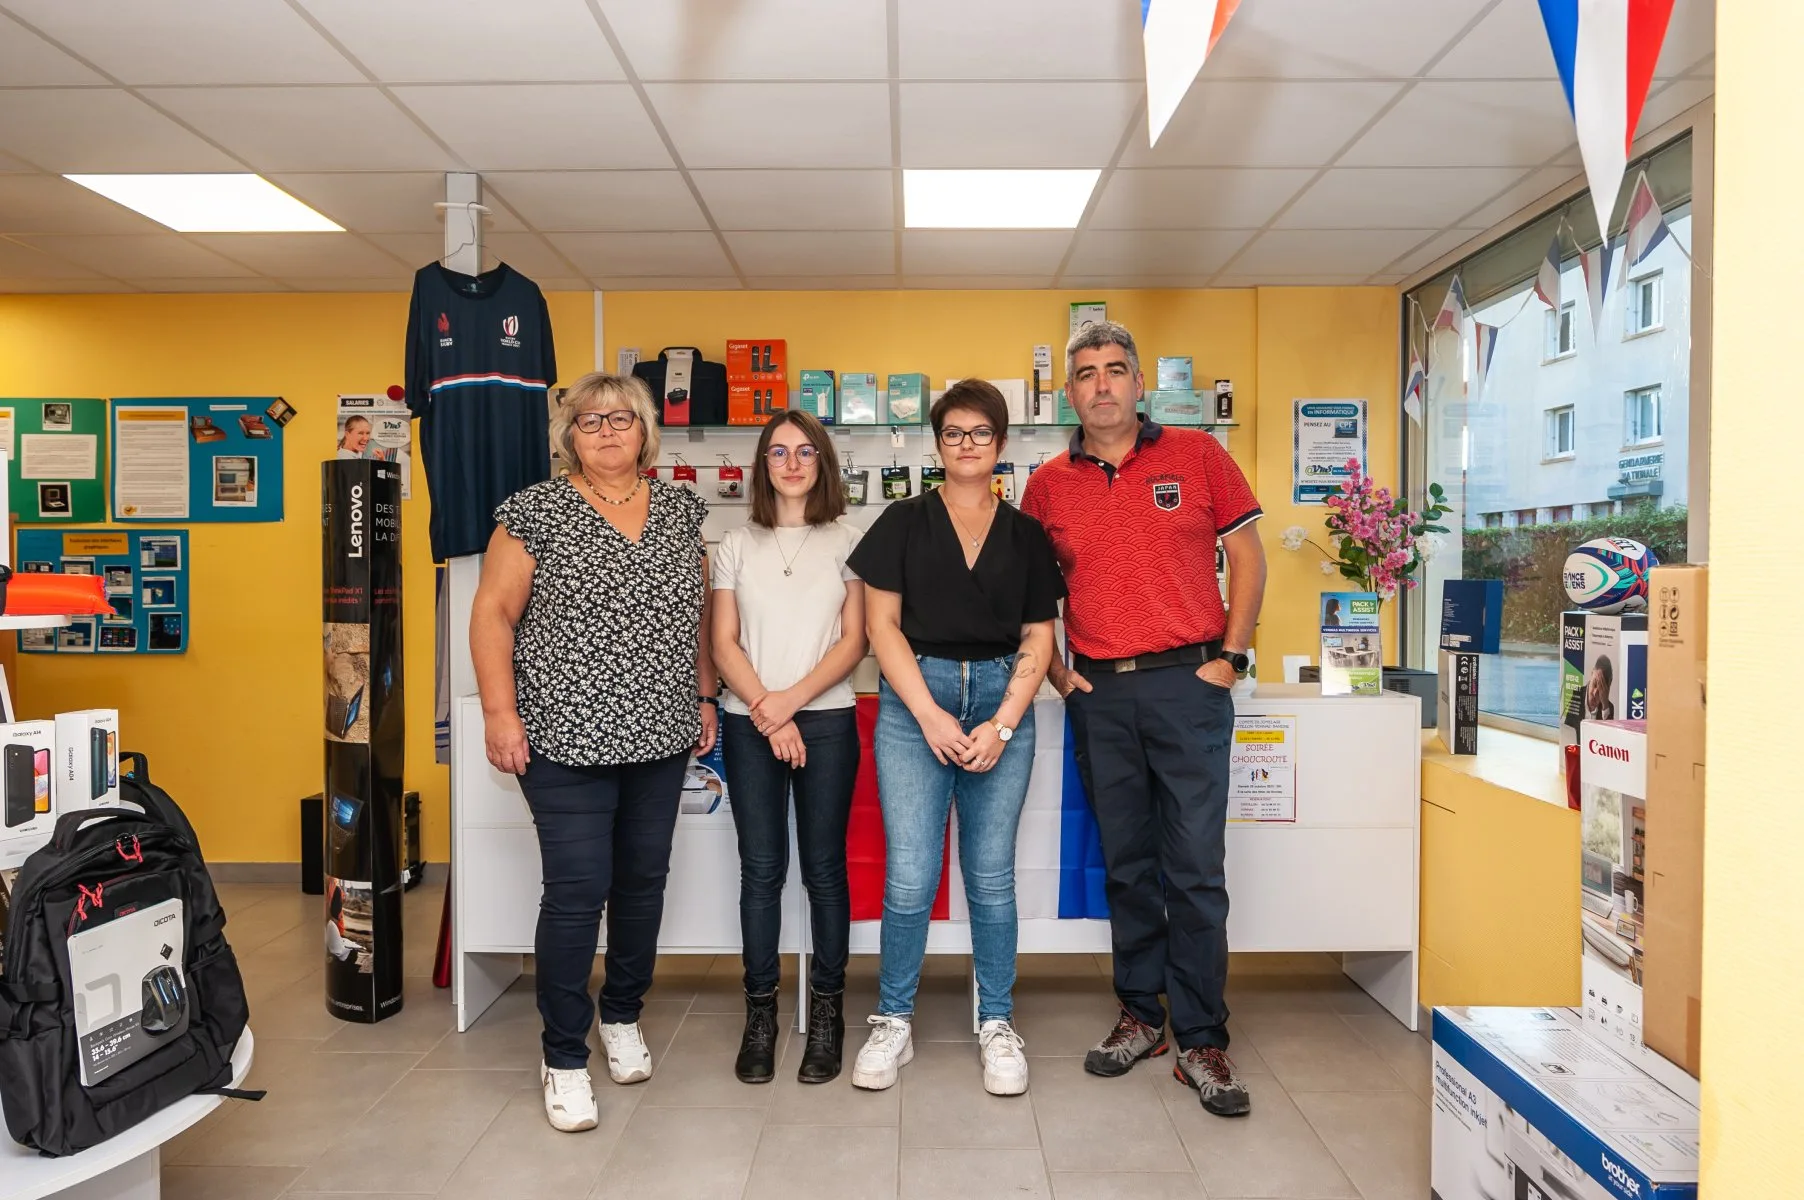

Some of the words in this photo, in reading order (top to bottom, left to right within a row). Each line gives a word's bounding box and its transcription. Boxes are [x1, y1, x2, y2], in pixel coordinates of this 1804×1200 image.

[1619, 454, 1663, 469] GENDARMERIE
[376, 503, 394, 513] DES
[348, 485, 363, 558] Lenovo
[375, 532, 388, 541] LA
[1564, 573, 1585, 581] RANCE
[1564, 581, 1585, 590] EVENS
[1564, 625, 1579, 637] PACK
[1564, 639, 1584, 651] ASSIST
[1588, 739, 1629, 762] Canon
[1231, 755, 1288, 763] CHOUCROUTE
[153, 913, 176, 927] DICOTA
[122, 1033, 131, 1041] cm
[1435, 1061, 1468, 1097] Professional
[1468, 1091, 1477, 1105] A3
[1435, 1075, 1470, 1112] multifunction
[1470, 1106, 1488, 1129] inkjet
[1601, 1152, 1640, 1195] brother
